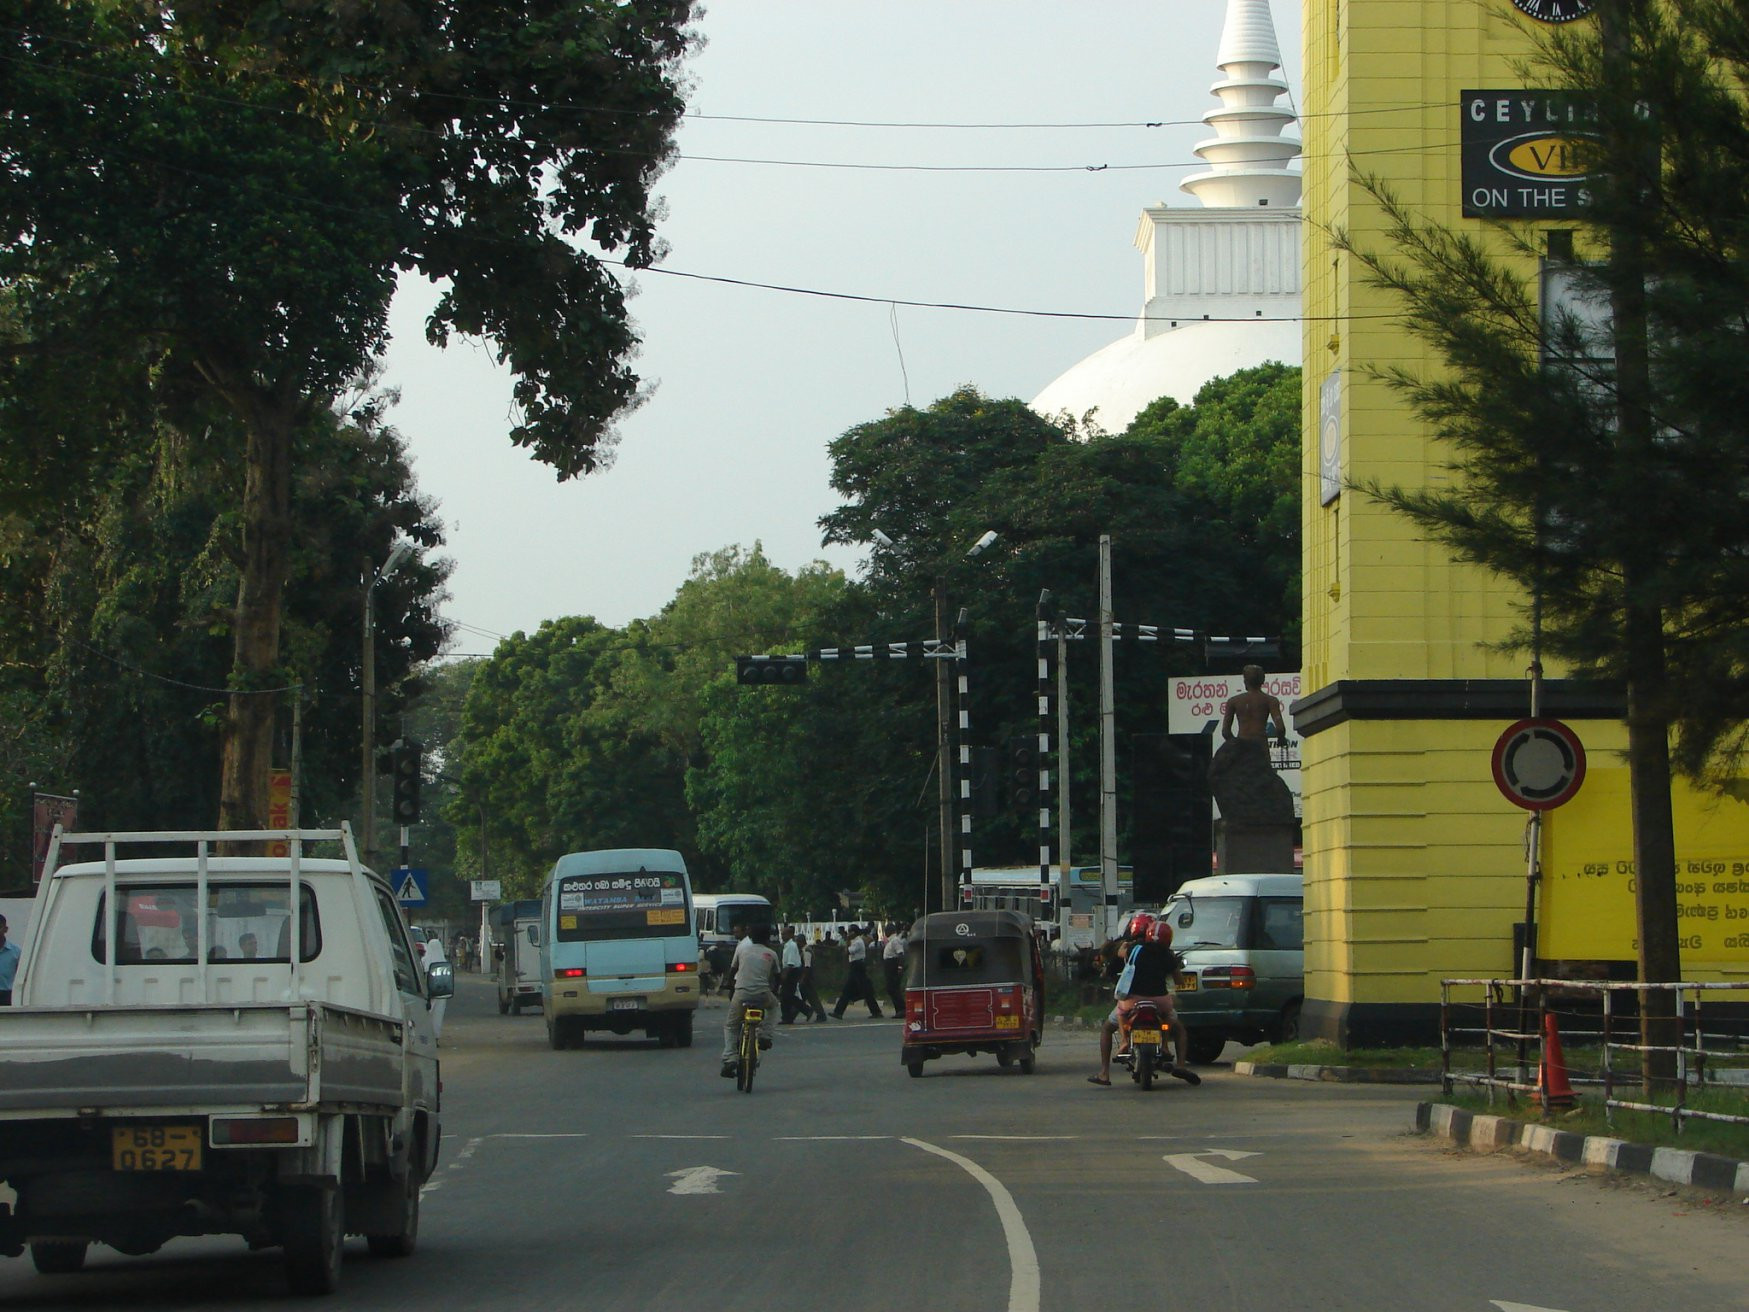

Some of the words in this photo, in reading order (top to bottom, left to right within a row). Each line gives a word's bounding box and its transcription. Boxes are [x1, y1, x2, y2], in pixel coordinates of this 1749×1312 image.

[1472, 188, 1508, 207] ON
[1517, 188, 1566, 207] THE
[121, 1149, 194, 1170] 0627
